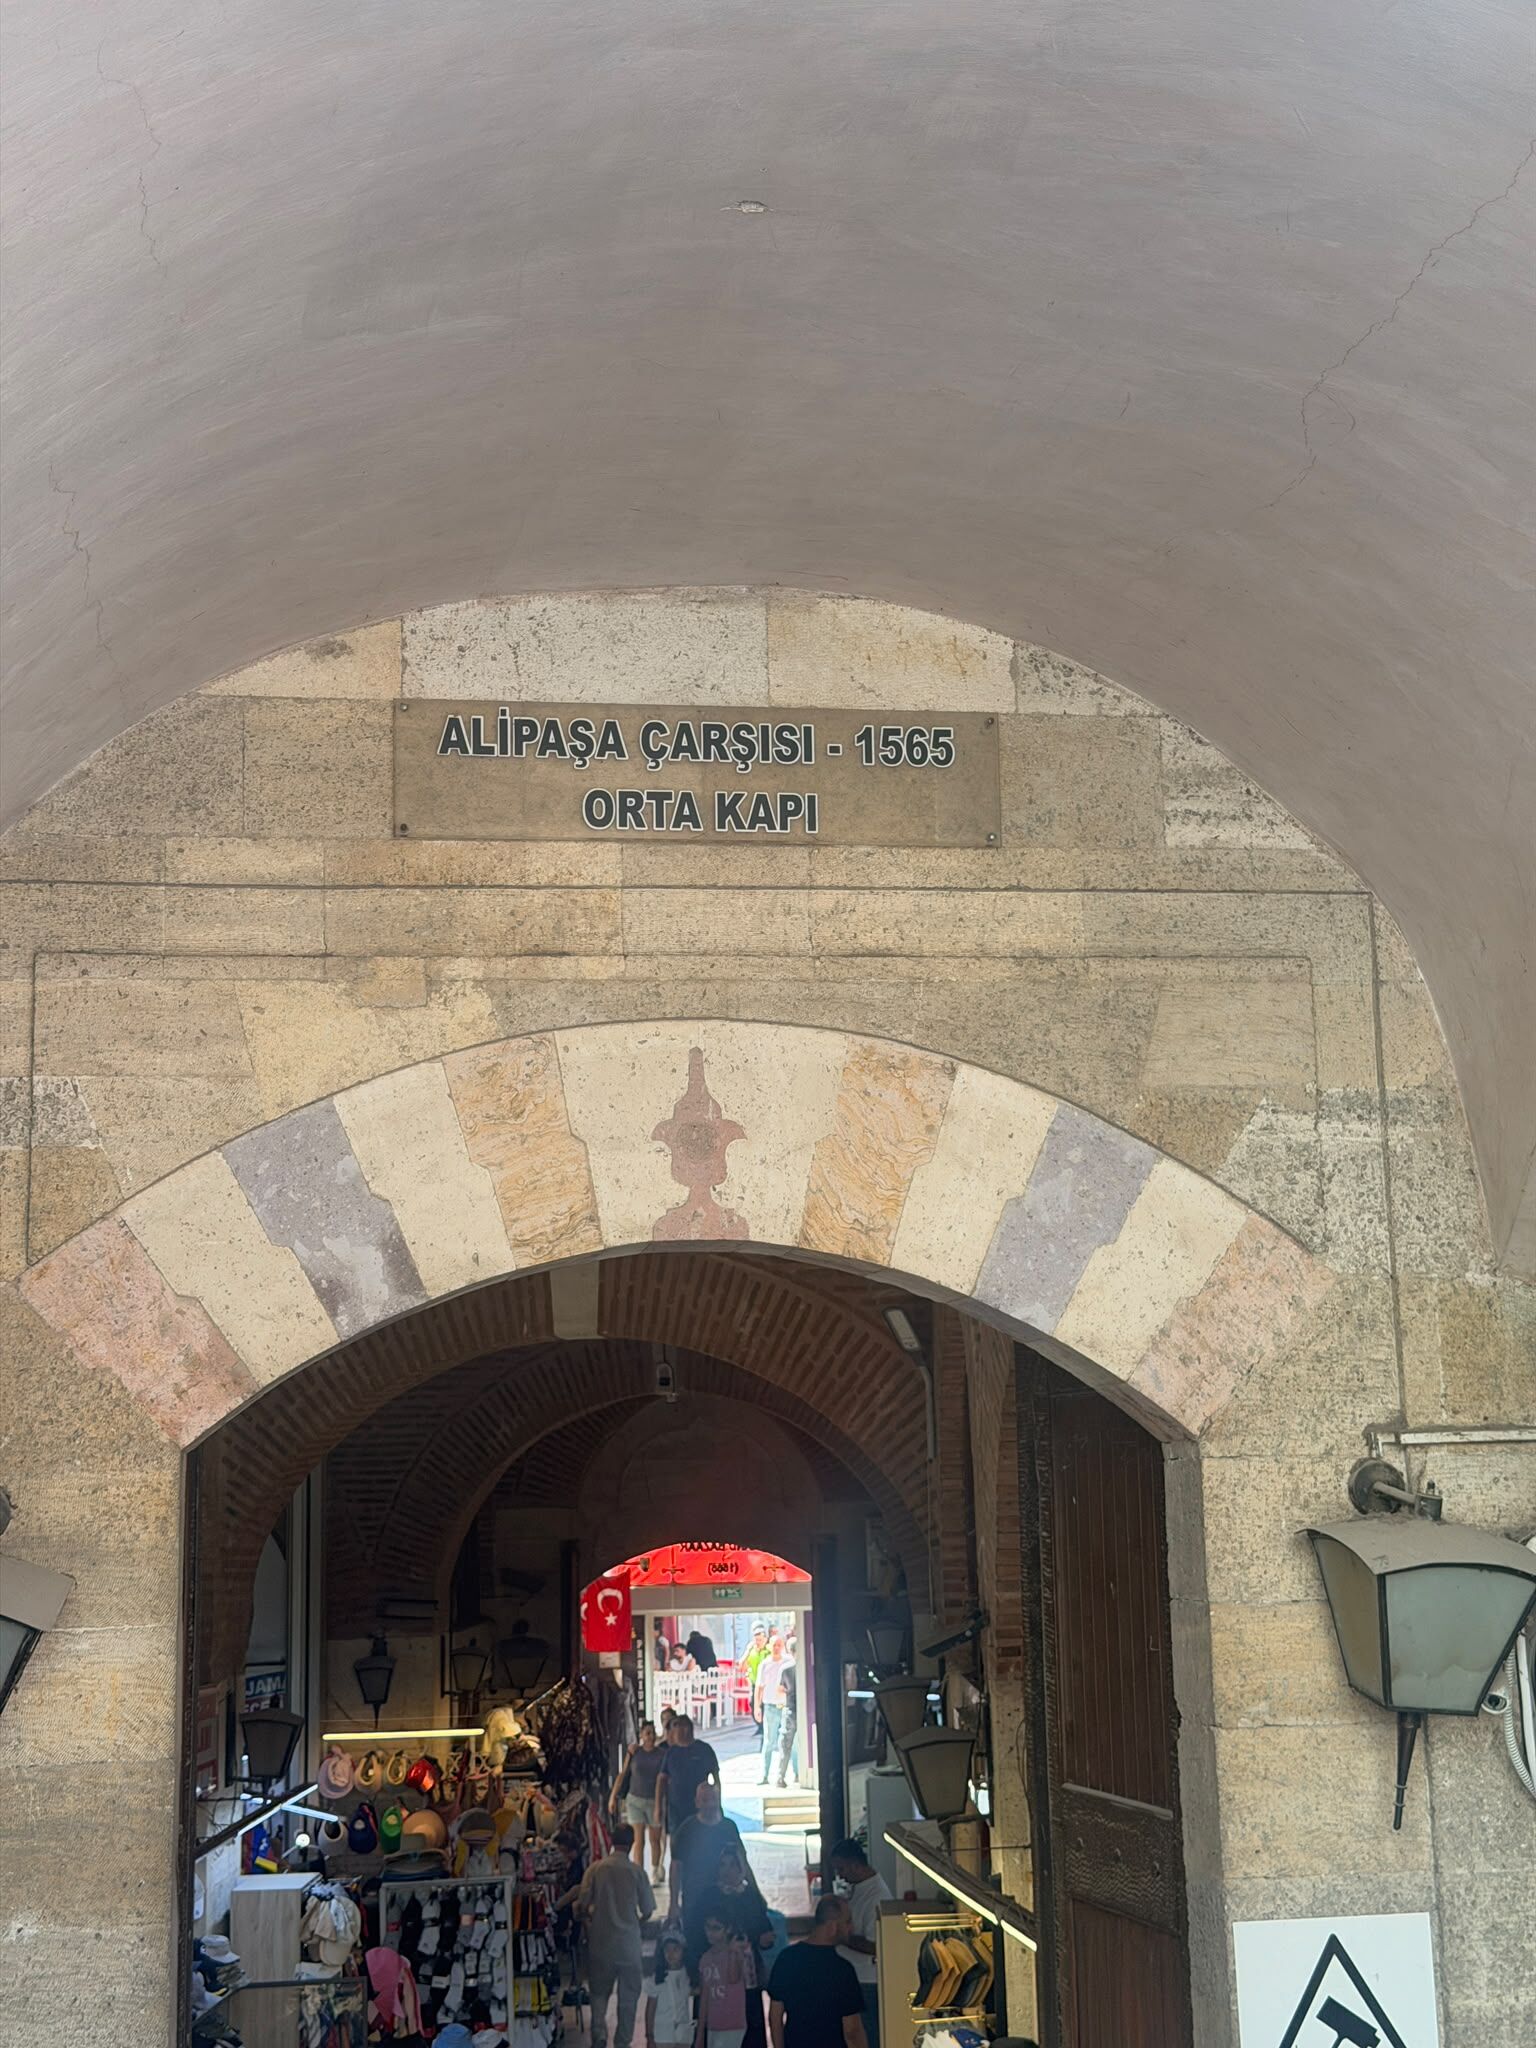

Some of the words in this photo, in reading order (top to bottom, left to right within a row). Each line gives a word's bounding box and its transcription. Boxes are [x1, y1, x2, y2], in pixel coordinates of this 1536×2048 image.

[437, 707, 629, 769] ALİPAŞA
[640, 720, 815, 773] ÇARŞISI
[827, 744, 843, 756] -
[854, 725, 956, 767] 1565
[582, 787, 704, 831] ORTA
[715, 791, 819, 833] KAPI
